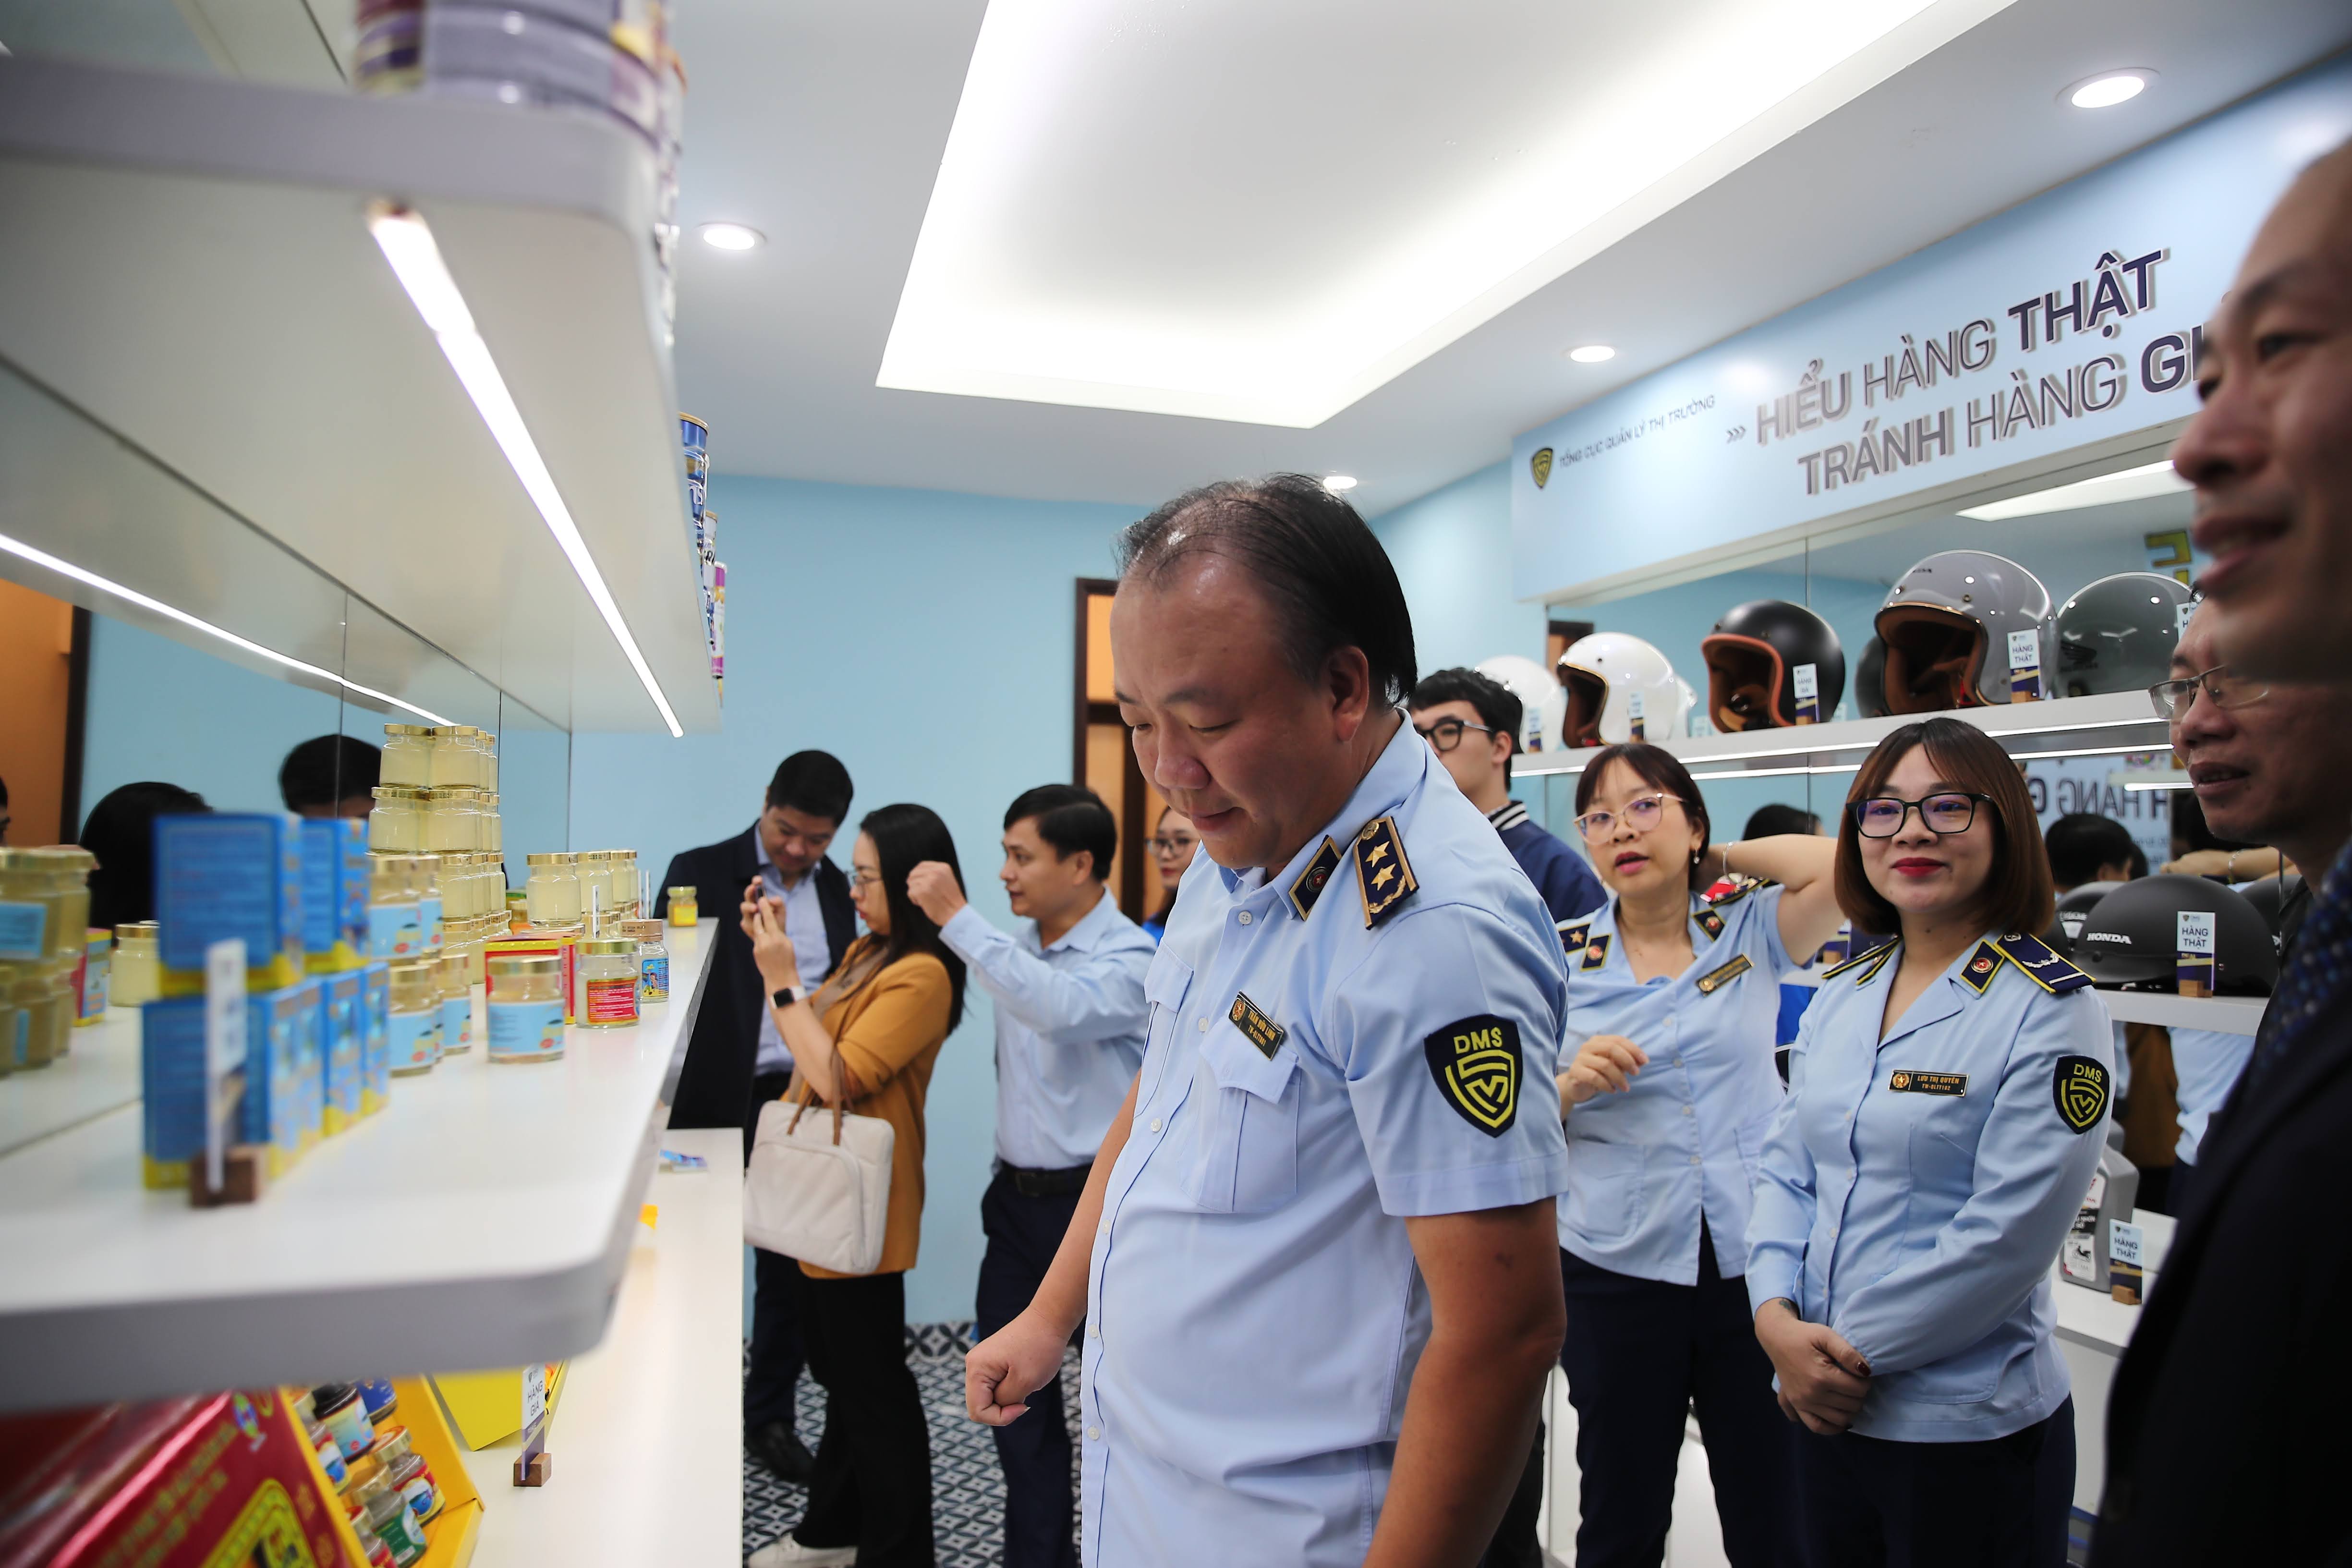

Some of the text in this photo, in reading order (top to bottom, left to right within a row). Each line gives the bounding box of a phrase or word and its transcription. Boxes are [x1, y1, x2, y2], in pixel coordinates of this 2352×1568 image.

[1757, 251, 2162, 445] HIỂU HÀNG THẬT
[1634, 420, 1647, 438] LÝ
[1649, 414, 1664, 433] THỊ
[1669, 394, 1716, 425] TRƯỜNG
[1797, 324, 2204, 495] TRÁNH HÀNG GI
[2012, 644, 2033, 653] HÀNG
[2086, 932, 2132, 944] HONDA
[2182, 925, 2208, 936] HÀNG
[2183, 937, 2207, 949] THẬT
[1454, 1027, 1503, 1054] DMS
[2073, 1063, 2102, 1083] DMS
[2114, 1237, 2138, 1250] HÀNG
[2116, 1247, 2136, 1261] THẬT
[528, 1380, 543, 1404] HÀNG
[530, 1396, 540, 1416] GIẢ
